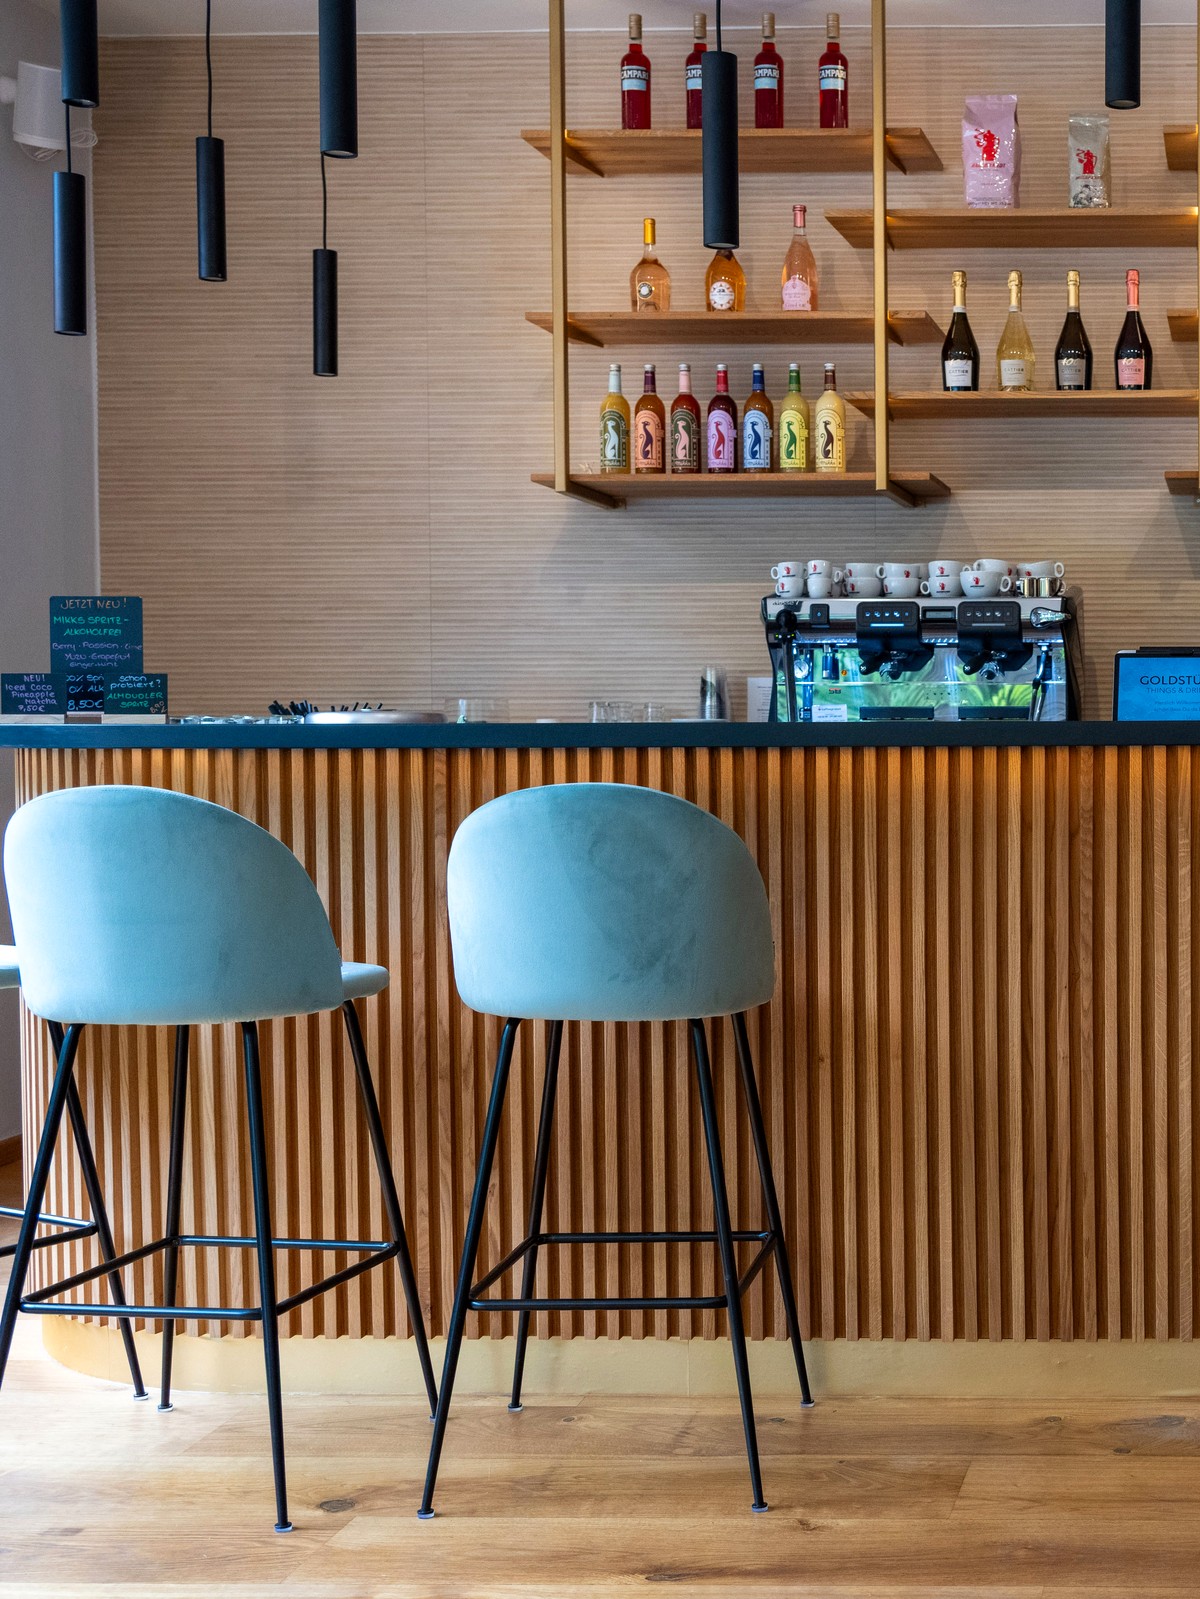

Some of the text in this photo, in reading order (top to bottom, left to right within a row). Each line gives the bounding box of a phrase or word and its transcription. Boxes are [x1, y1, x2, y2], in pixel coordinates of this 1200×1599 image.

[685, 69, 702, 79] CAMP
[60, 599, 93, 610] JETZT
[53, 616, 87, 625] MIKKS
[63, 628, 122, 636] ALKOHOLFREI
[24, 674, 45, 682] NEU!
[5, 683, 52, 691] Iced Coco
[11, 691, 55, 699] Pineapple
[107, 692, 163, 700] ALMDUDLER
